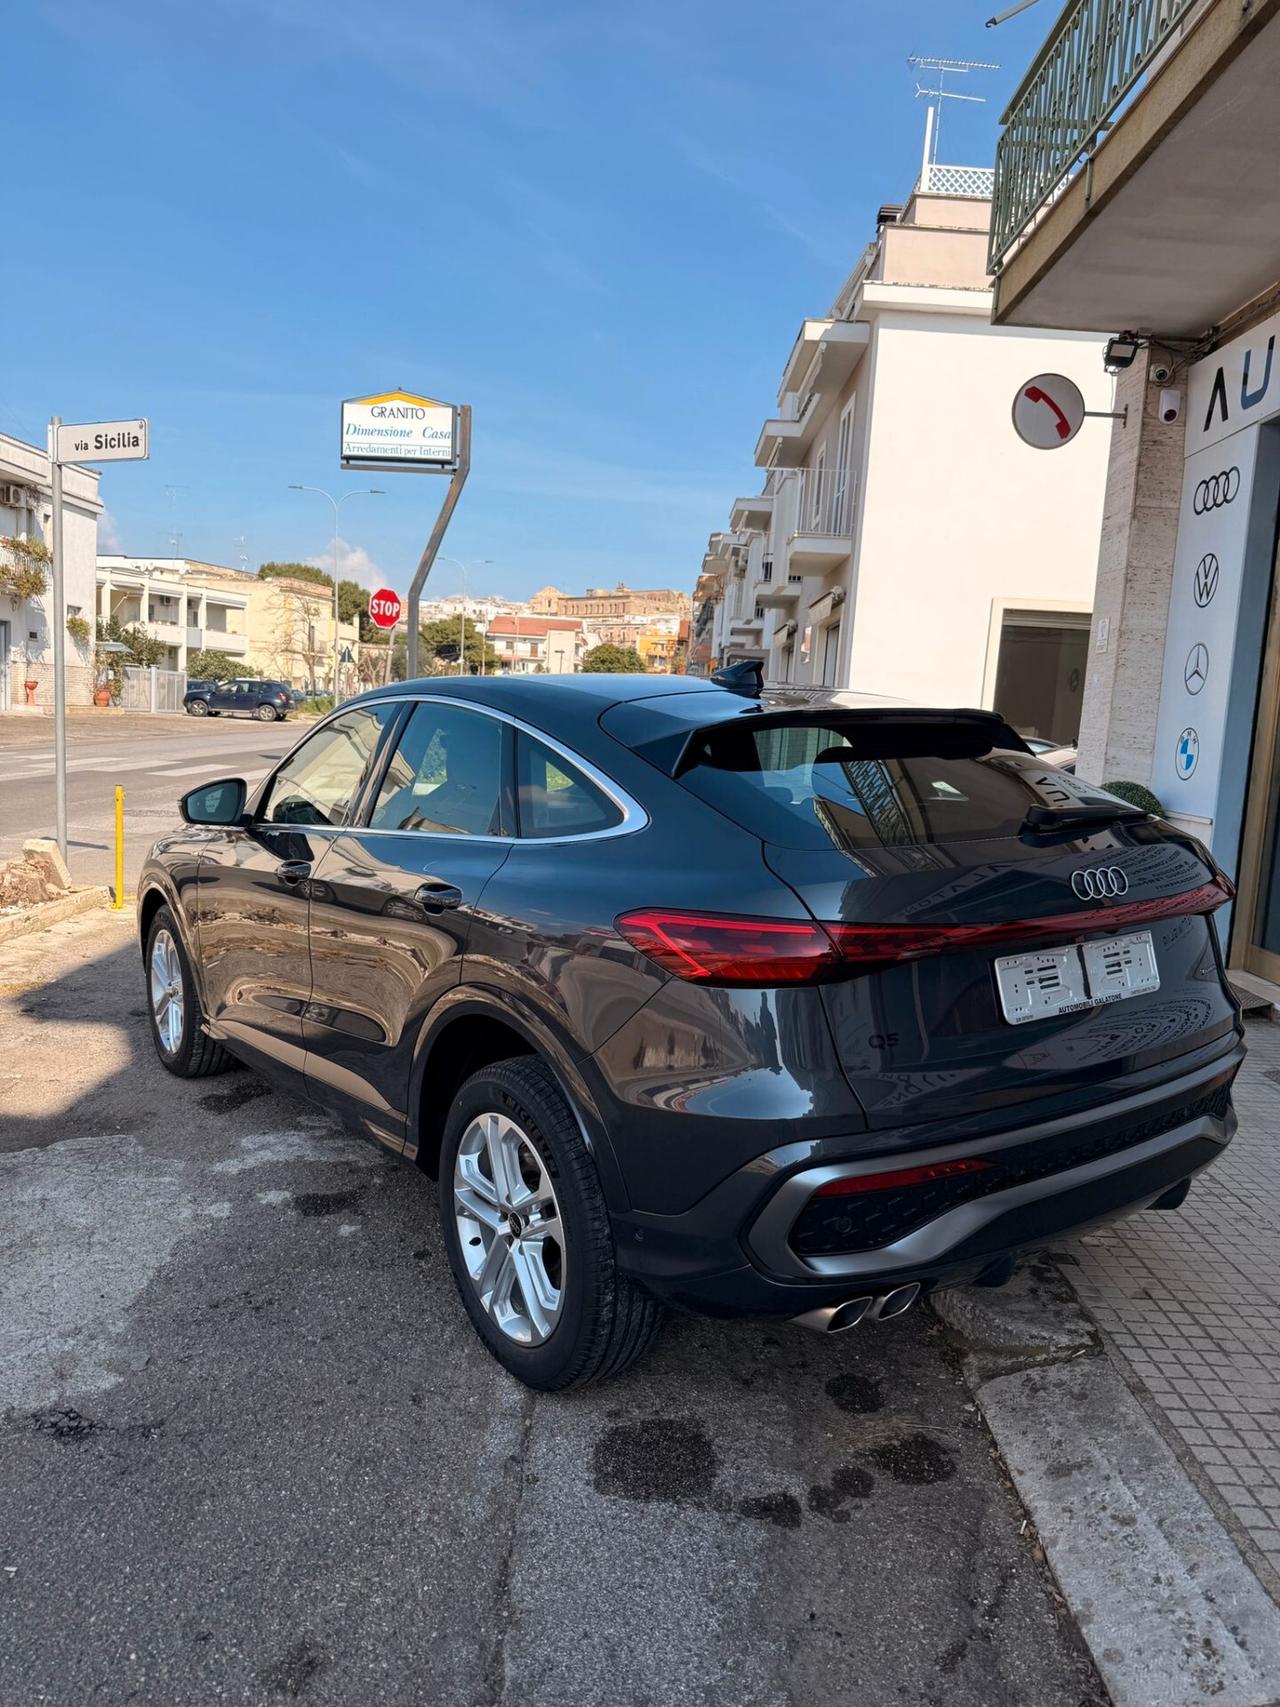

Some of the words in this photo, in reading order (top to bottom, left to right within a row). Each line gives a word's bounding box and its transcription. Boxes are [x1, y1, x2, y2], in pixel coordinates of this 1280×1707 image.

[370, 406, 426, 420] GRANITO
[345, 423, 413, 438] Dimensione
[422, 426, 451, 440] Casa
[74, 440, 89, 451] via
[94, 432, 139, 450] Sicilia
[344, 443, 402, 455] Arredamenti
[404, 448, 417, 456] per
[419, 446, 451, 457] Interni
[371, 598, 400, 617] STOP
[1058, 1000, 1094, 1014] AUTOMOBILI
[1094, 993, 1122, 1006] GALATONE
[868, 1032, 899, 1050] Q5
